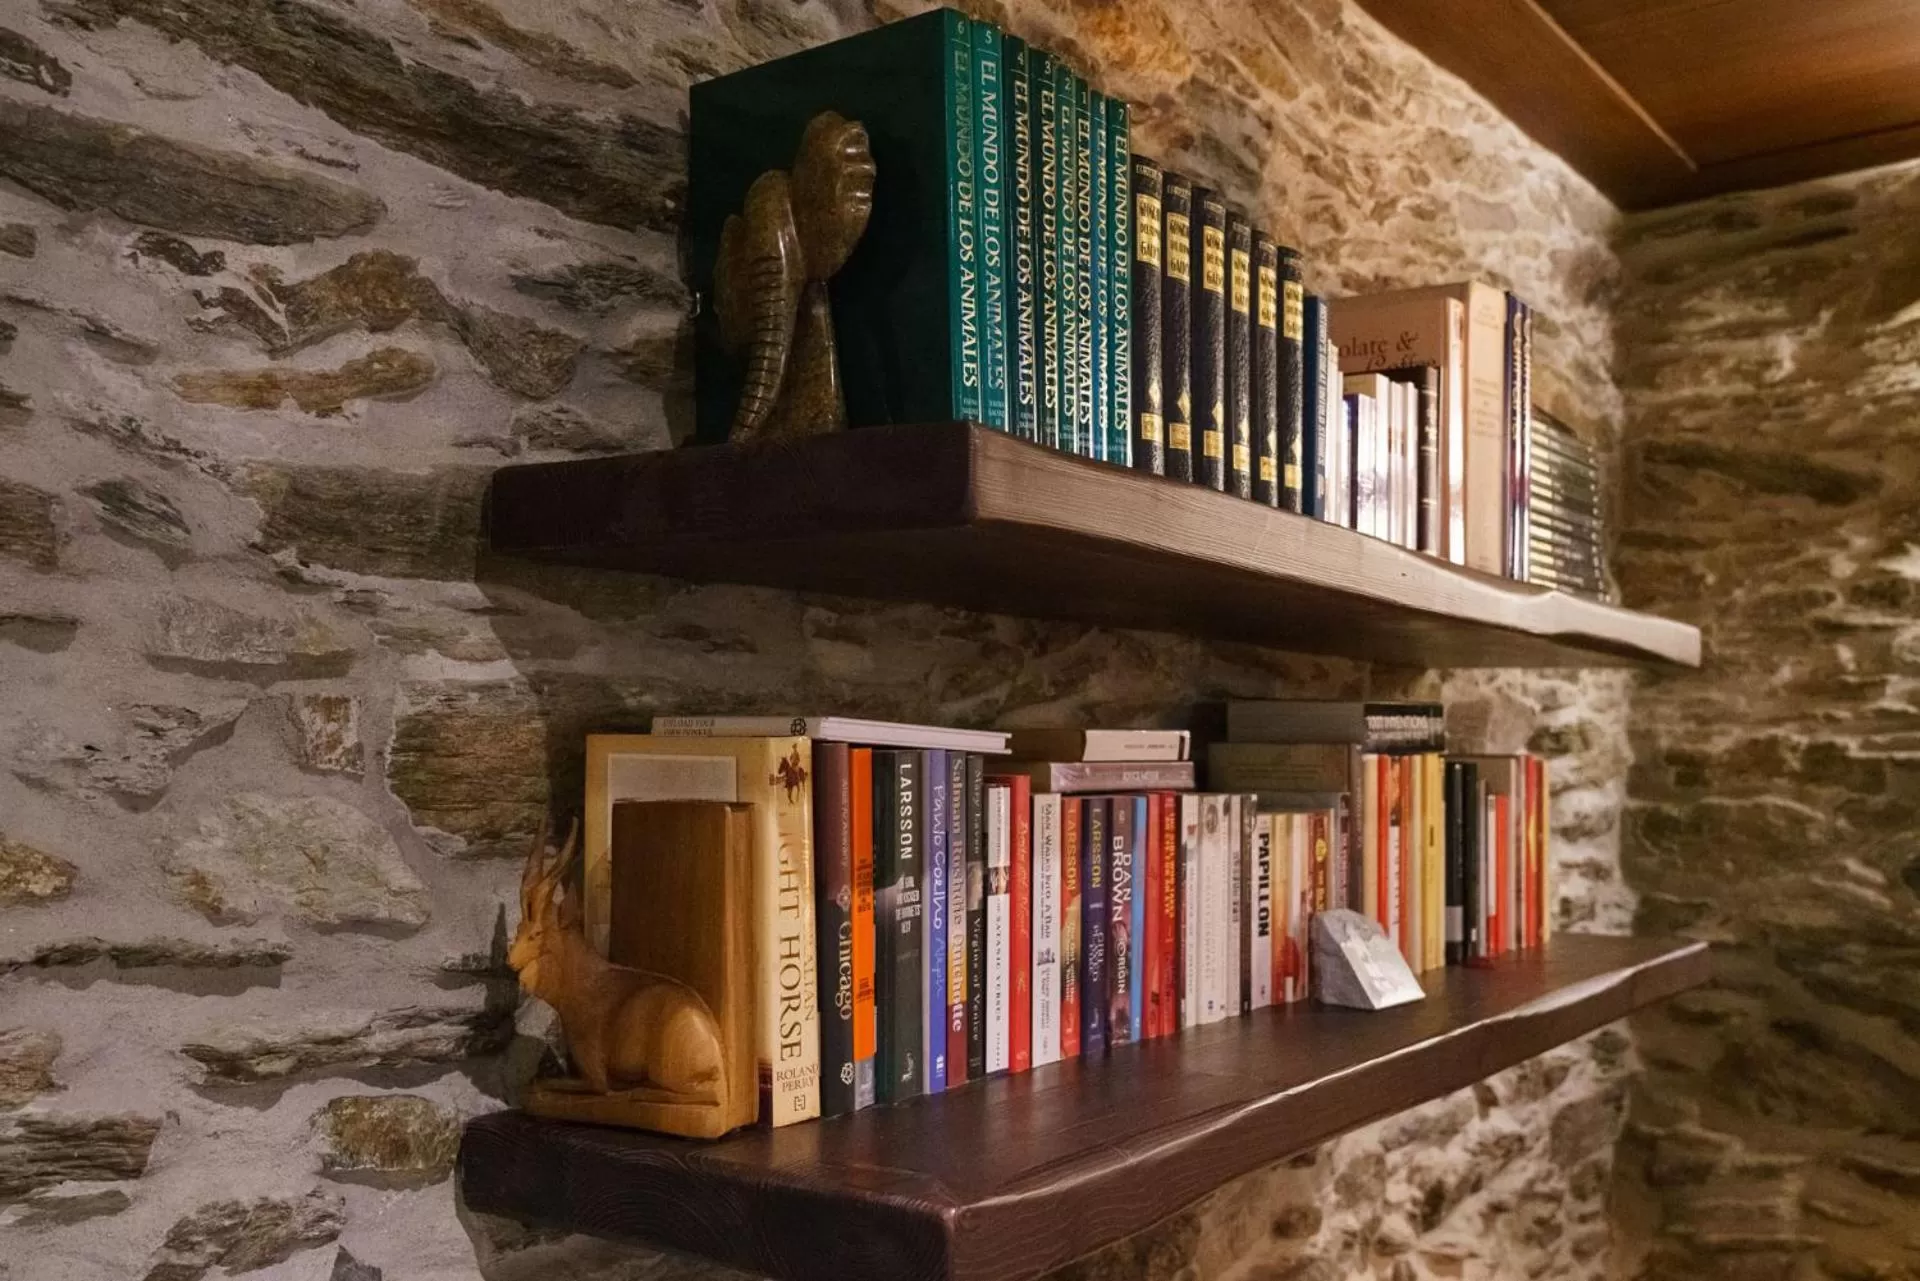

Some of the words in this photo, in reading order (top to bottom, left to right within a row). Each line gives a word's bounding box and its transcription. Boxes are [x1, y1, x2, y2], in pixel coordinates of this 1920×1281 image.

[957, 20, 964, 34] 6
[985, 30, 992, 44] 5
[981, 59, 997, 86] EL
[1017, 52, 1024, 65] 4
[1044, 60, 1050, 74] 3
[1014, 79, 1028, 103] EL
[1041, 89, 1055, 117] EL
[1064, 77, 1071, 91] 2
[1081, 91, 1087, 105] 1
[1061, 104, 1071, 131] EL
[1078, 117, 1090, 145] EL
[1118, 108, 1124, 121] 7
[981, 91, 998, 184] MUNDO
[1015, 110, 1030, 203] MUNDO
[1097, 128, 1107, 153] EL
[1114, 135, 1127, 160] EL
[1041, 121, 1056, 210] MUNDO
[1061, 135, 1075, 223] MUNDO
[957, 181, 973, 217] DE
[983, 188, 1000, 222] DE
[1078, 149, 1091, 233] MUNDO
[1097, 157, 1108, 238] MUNDO
[1114, 165, 1128, 245] MUNDO
[959, 220, 974, 262] LOS
[1016, 206, 1032, 239] DE
[1042, 213, 1057, 246] DE
[1062, 227, 1076, 258] DE
[985, 225, 1000, 268] LOS
[1017, 242, 1032, 285] LOS
[1043, 248, 1057, 286] LOS
[1078, 236, 1091, 262] DE
[1098, 242, 1108, 272] DE
[1114, 252, 1128, 279] DE
[1062, 262, 1076, 301] LOS
[1078, 265, 1091, 311] LOS
[1098, 276, 1108, 317] LOS
[1114, 281, 1128, 321] LOS
[960, 266, 978, 388] ANIMALES
[985, 271, 1004, 390] ANIMALES
[1017, 291, 1035, 406] ANIMALES
[1396, 331, 1420, 353] &
[1043, 293, 1057, 409] ANIMALES
[1063, 305, 1077, 418] ANIMALES
[1078, 313, 1092, 425] ANIMALES
[1098, 320, 1109, 429] ANIMALES
[1114, 324, 1129, 431] ANIMALES
[900, 763, 913, 860] LARSSON
[933, 785, 946, 846] Paulo
[952, 758, 964, 834] Salman
[1067, 808, 1077, 891] LARSSON
[1092, 807, 1103, 889] LARSSON
[932, 850, 946, 929] Coelho
[952, 840, 965, 925] Rushdie
[1112, 835, 1124, 922] BROWN
[1122, 852, 1132, 901] DAN
[1257, 832, 1270, 937] PAPILLON
[972, 917, 982, 966] Virgins
[835, 919, 852, 1021] Chicago
[952, 934, 965, 1033] Quichotte
[973, 974, 982, 988] of
[1115, 940, 1126, 994] ORIGIN
[779, 935, 802, 1062] HORSE
[972, 993, 982, 1041] Venice
[776, 1063, 820, 1081] ROLAND
[781, 1077, 817, 1093] PERRY
